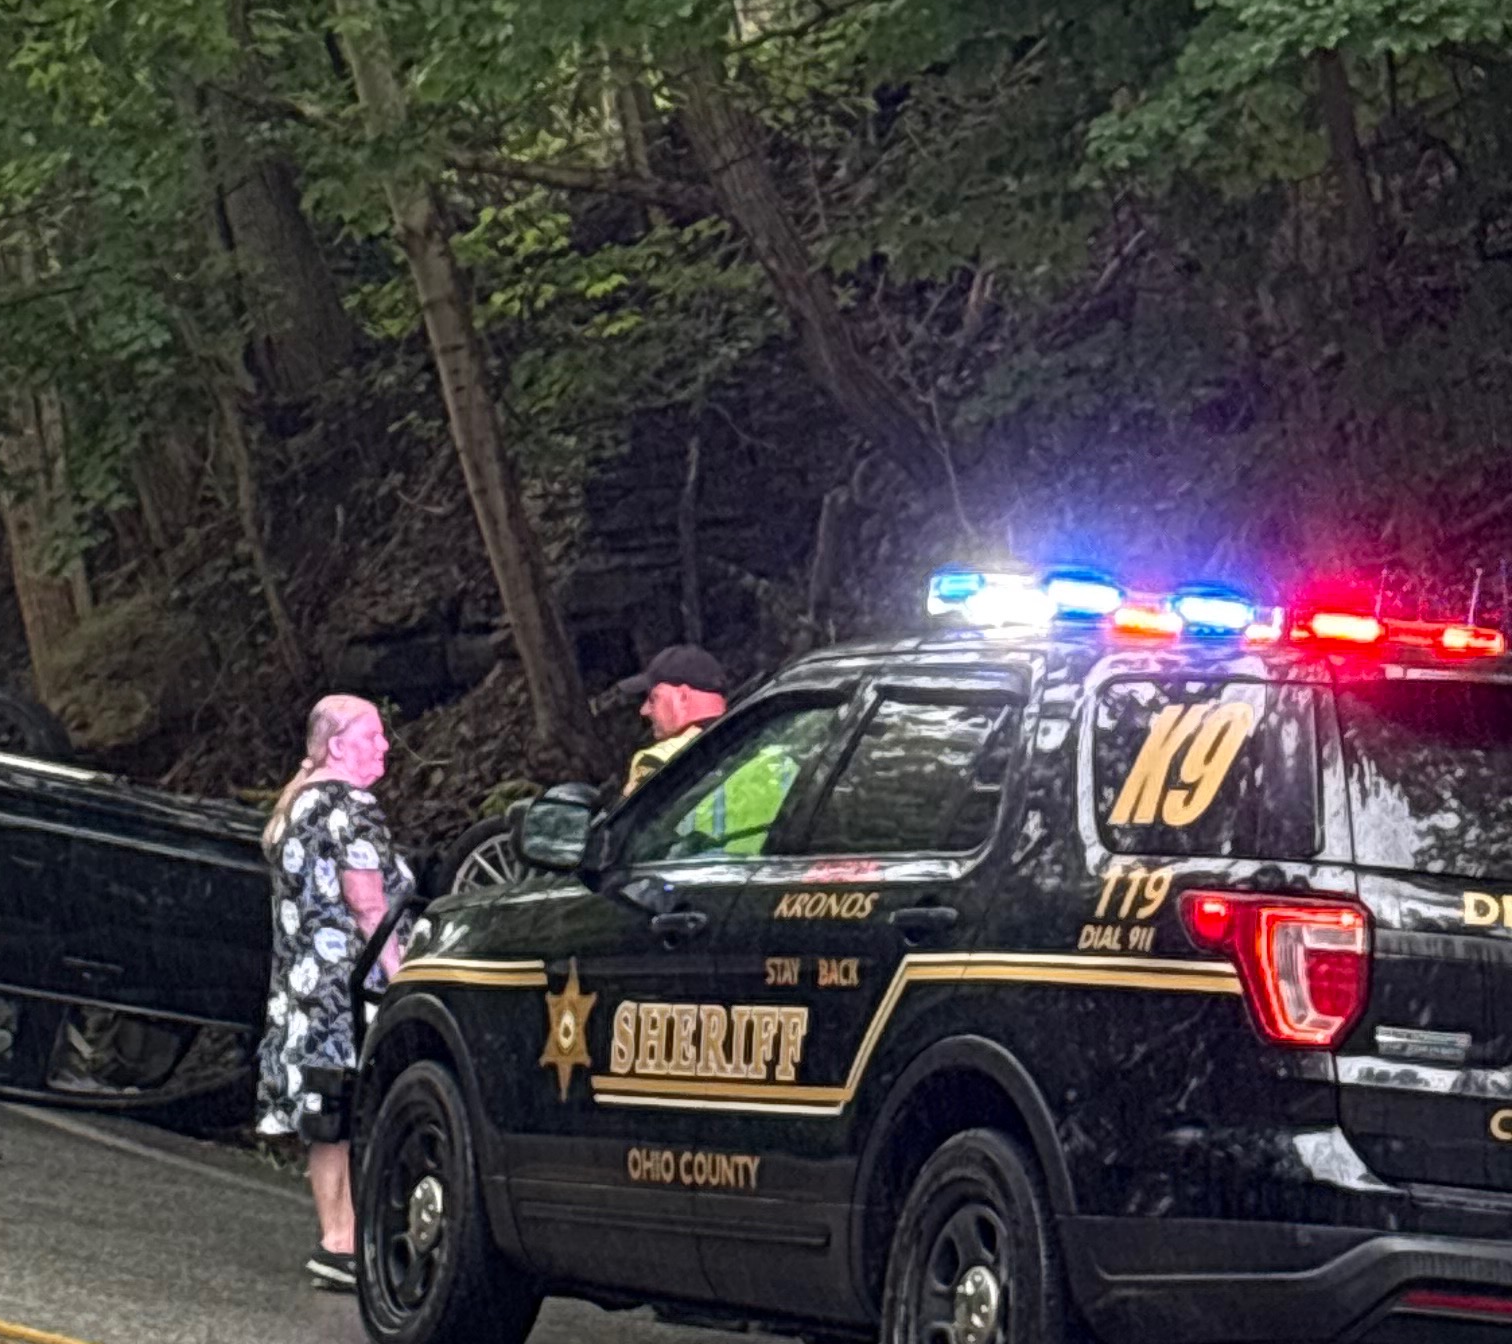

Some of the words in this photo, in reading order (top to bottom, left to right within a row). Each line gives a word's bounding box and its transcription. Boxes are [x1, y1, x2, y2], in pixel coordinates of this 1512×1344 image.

[1107, 703, 1254, 826] K9
[774, 892, 879, 918] KRONOS
[1077, 924, 1122, 950] DIAL
[1129, 925, 1156, 952] 911
[765, 958, 800, 985] STAY
[817, 958, 859, 987] BACK
[610, 1000, 809, 1081] SHERIFF
[627, 1147, 675, 1184] OHIO
[679, 1151, 760, 1189] COUNTY
